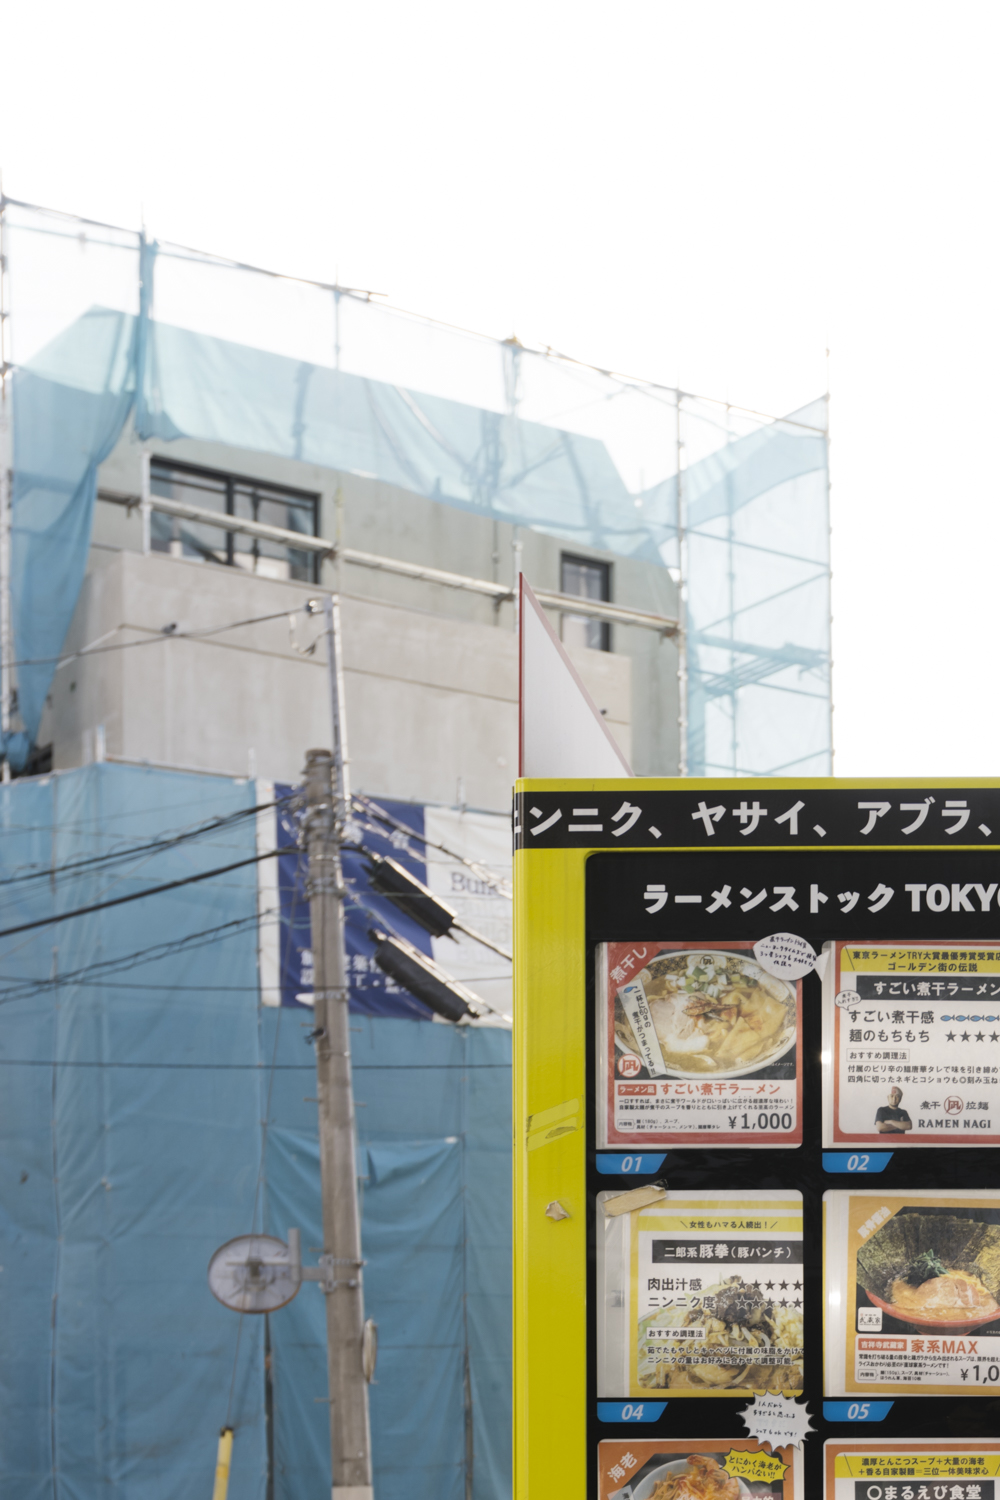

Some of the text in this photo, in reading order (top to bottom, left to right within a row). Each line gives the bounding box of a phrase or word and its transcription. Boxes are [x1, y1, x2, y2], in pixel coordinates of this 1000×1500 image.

[644, 883, 895, 914] ラーメンストック
[610, 947, 647, 983] 煮干し
[888, 963, 978, 972] ゴールデン街の伝説
[849, 1010, 934, 1024] すごい煮干感
[849, 1029, 930, 1043] 麺のもちもち
[661, 1084, 780, 1095] すごい煮干ラーメン
[729, 1113, 792, 1129] ¥1,000
[918, 1119, 991, 1129] RAMEN NAGI
[621, 1157, 642, 1172] 01
[847, 1155, 870, 1170] 02
[664, 1247, 698, 1257] 二郎系
[648, 1278, 702, 1291] 肉出汁感
[648, 1296, 715, 1309] ニンニク度
[911, 1340, 978, 1354] 家系MAX
[622, 1405, 643, 1420] 04
[847, 1403, 870, 1419] 05
[607, 1452, 638, 1483] 海老
